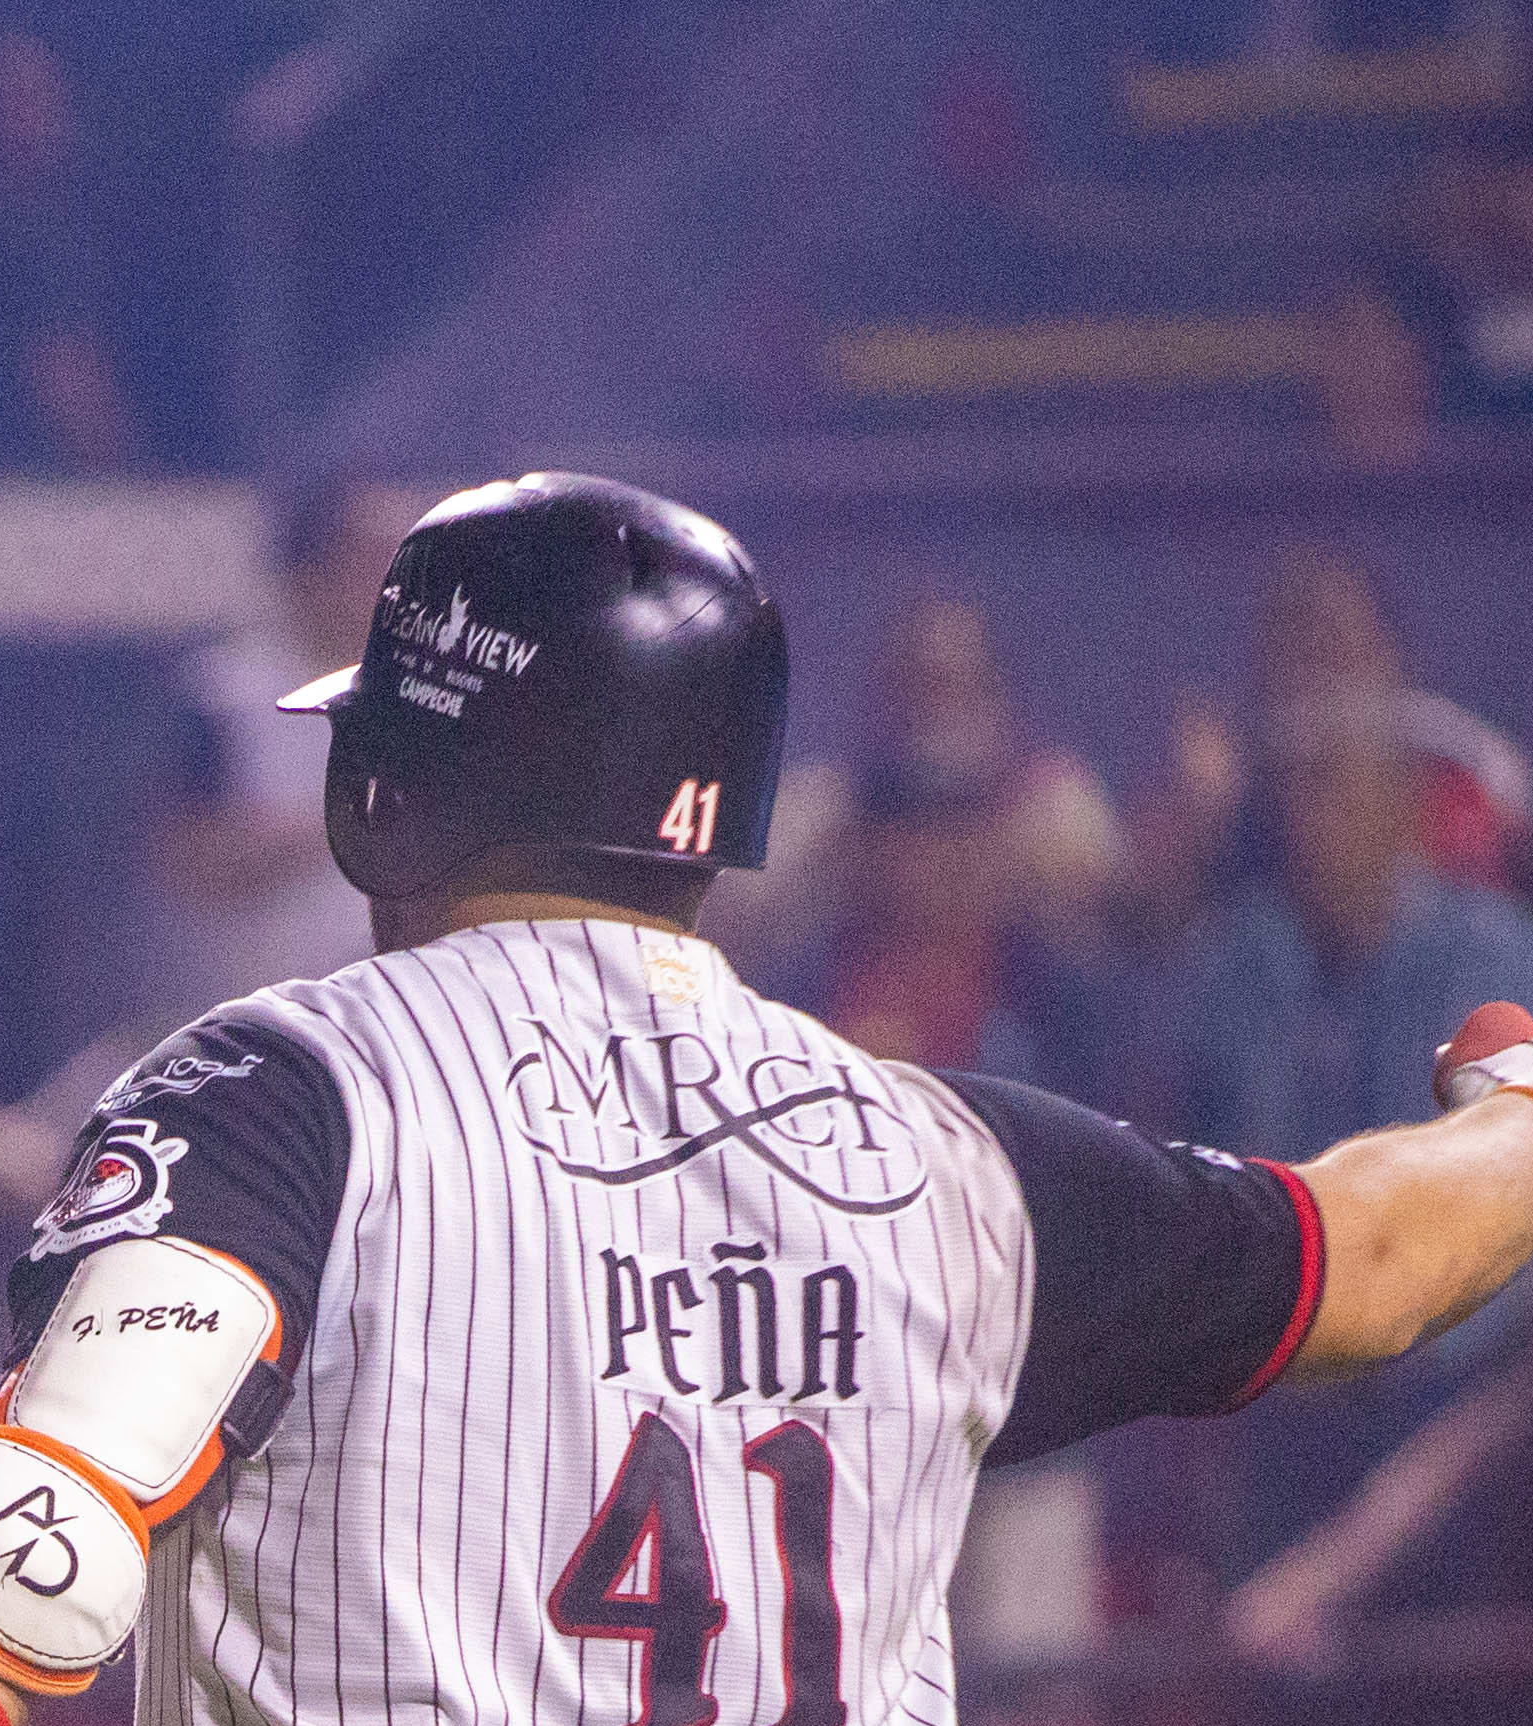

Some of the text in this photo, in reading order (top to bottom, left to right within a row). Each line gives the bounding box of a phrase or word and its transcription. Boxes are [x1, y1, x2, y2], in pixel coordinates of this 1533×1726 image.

[466, 622, 539, 677] VIEW
[399, 675, 466, 718] CAMPECHE
[659, 778, 722, 853] 41
[119, 1301, 221, 1333] PEÑA
[599, 1241, 864, 1403] PEÑA
